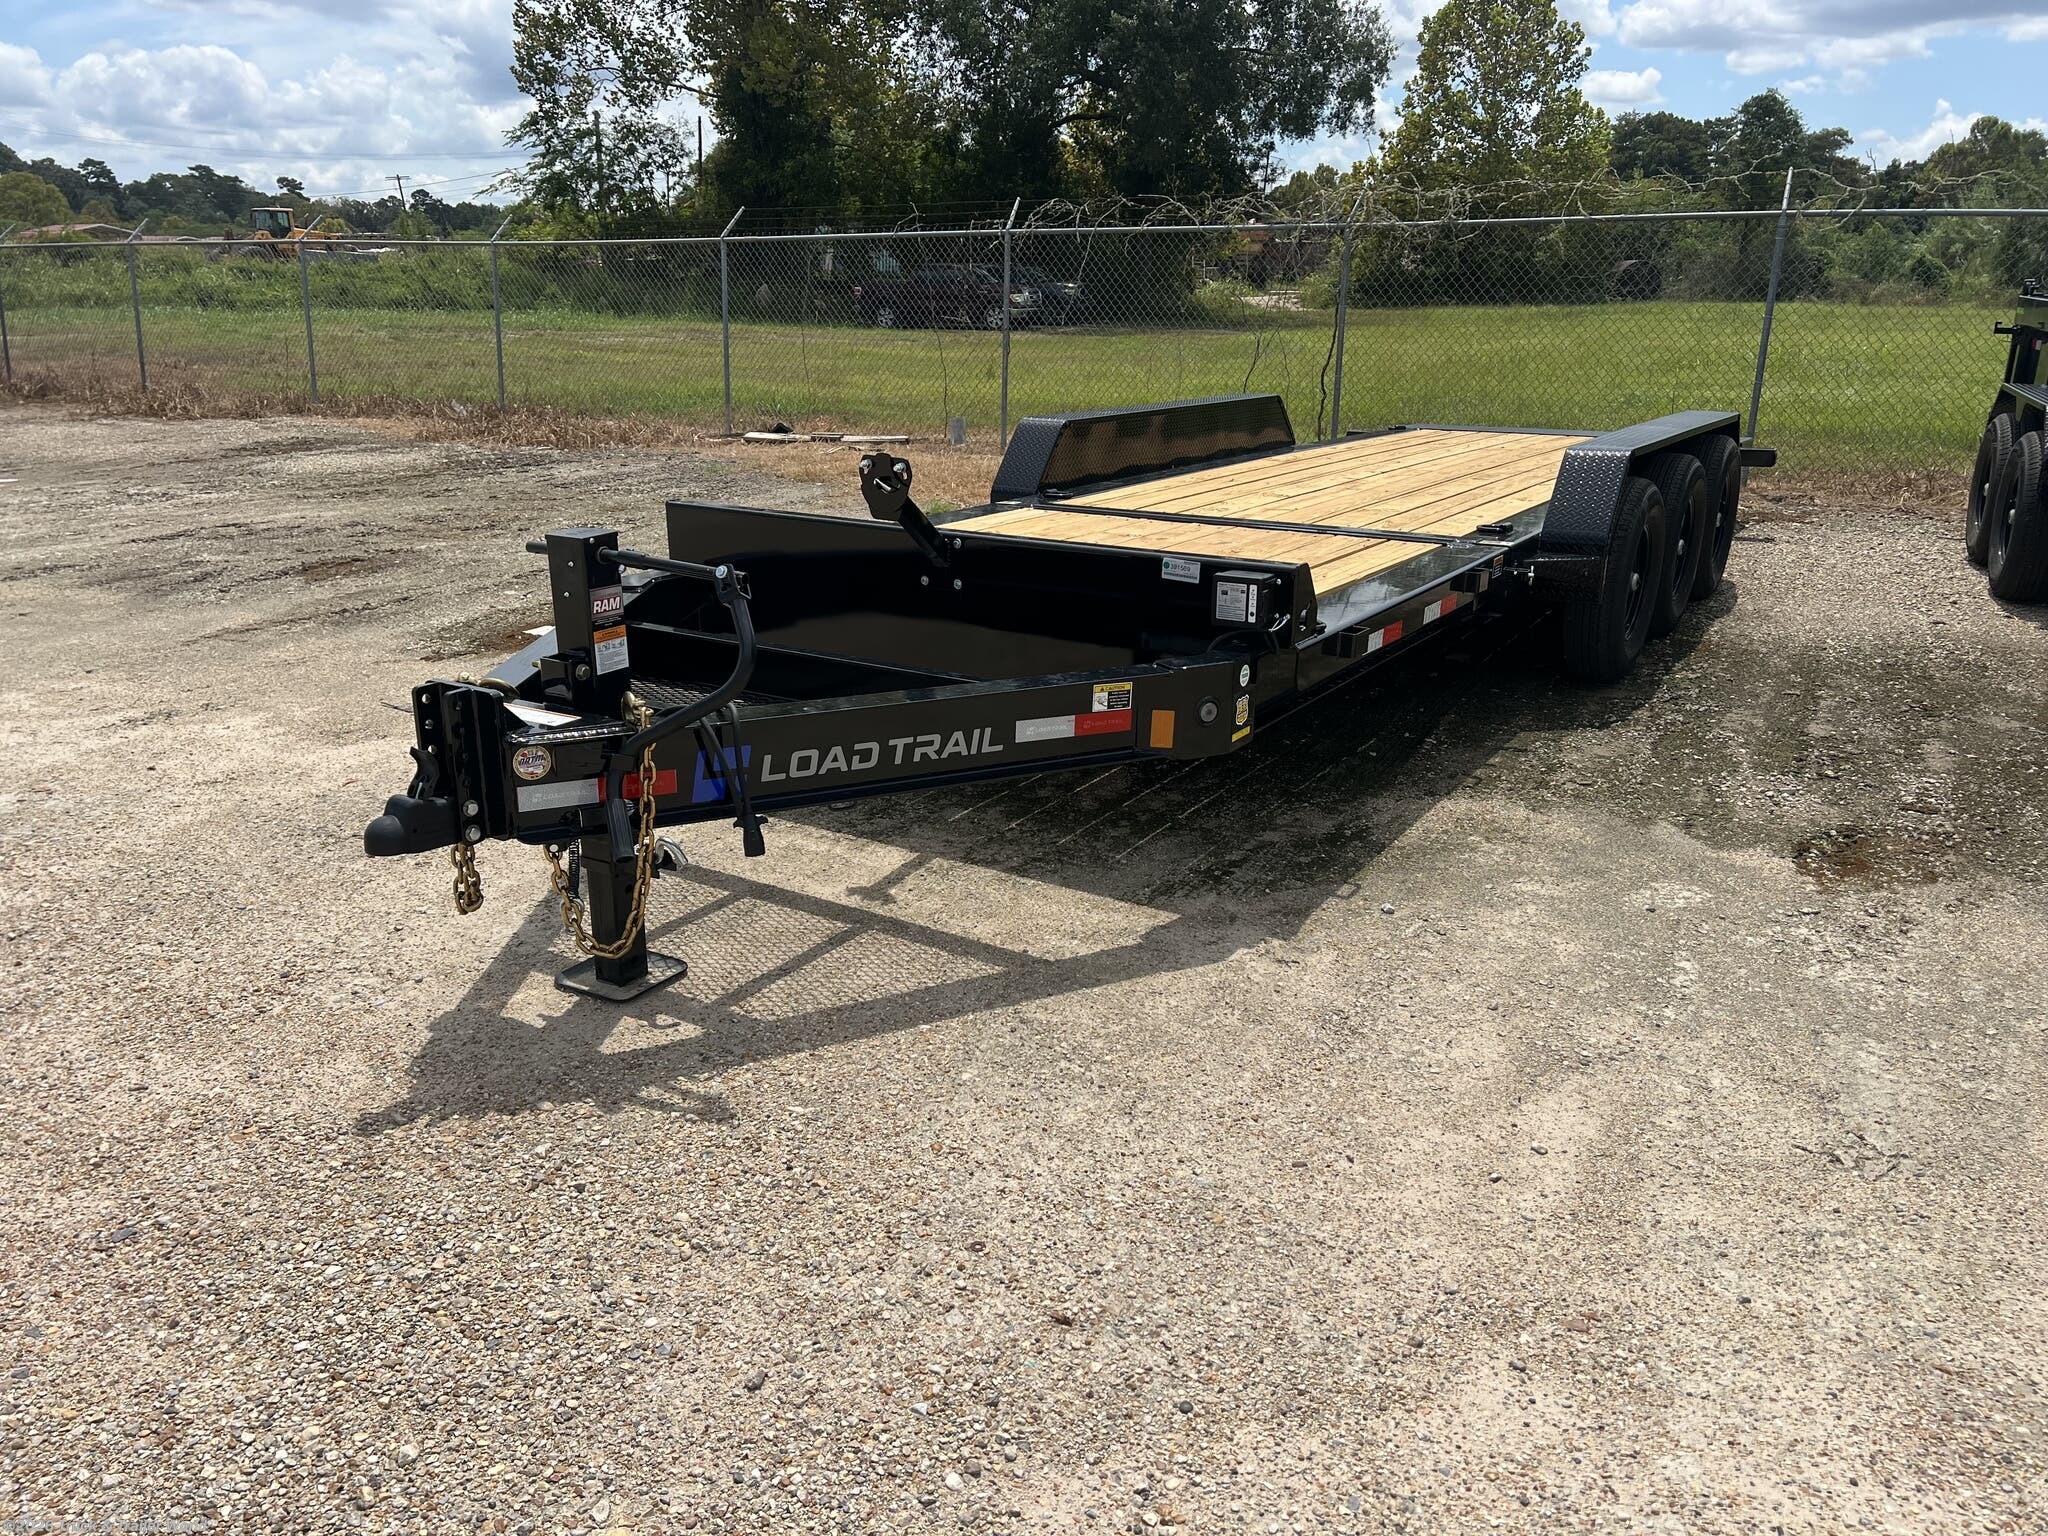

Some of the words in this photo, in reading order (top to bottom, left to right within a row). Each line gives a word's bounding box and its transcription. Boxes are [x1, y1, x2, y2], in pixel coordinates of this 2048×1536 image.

[593, 597, 620, 613] RAM
[1105, 684, 1126, 692] CAUTION
[760, 741, 880, 782] LOAD
[889, 727, 1004, 765] TRAIL
